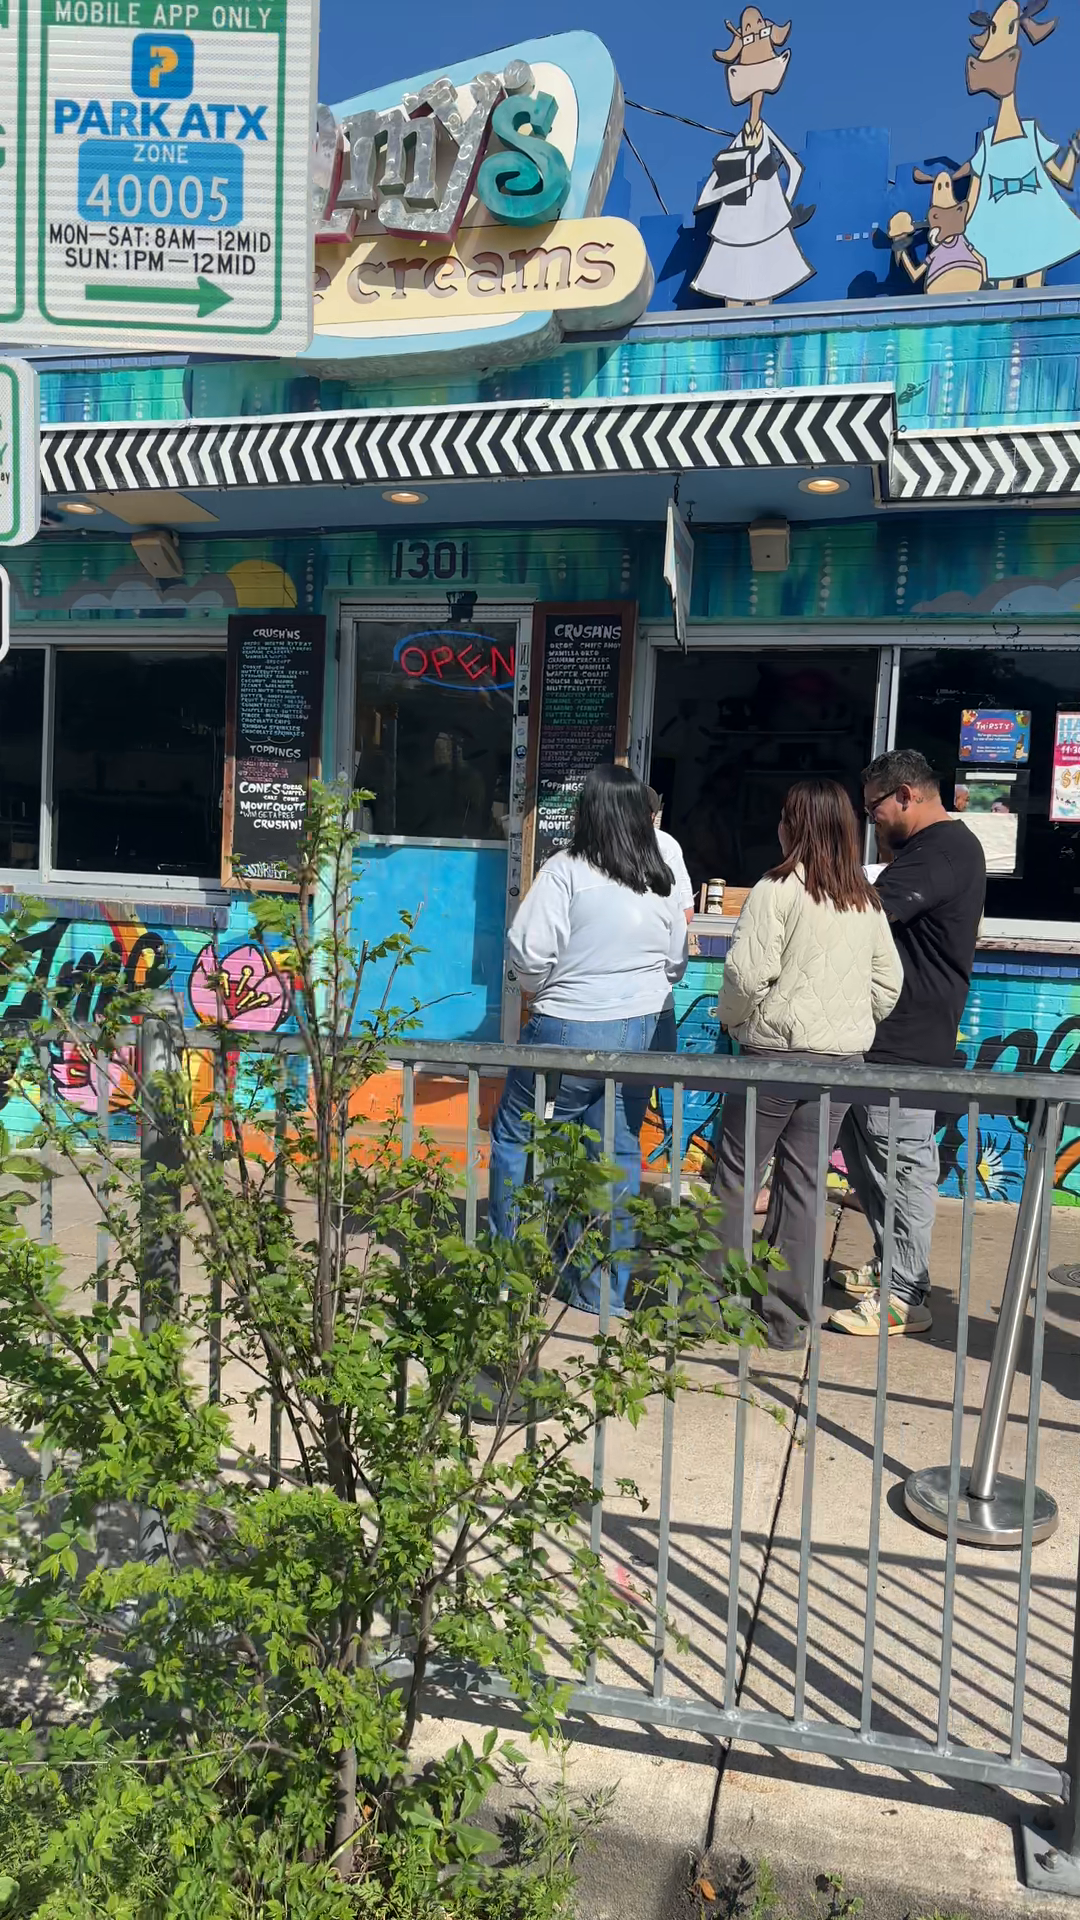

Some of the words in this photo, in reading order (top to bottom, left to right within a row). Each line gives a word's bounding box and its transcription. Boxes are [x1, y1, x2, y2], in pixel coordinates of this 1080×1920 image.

[55, 2, 140, 26] MOBILE
[153, 5, 199, 27] APP
[212, 6, 272, 30] ONLY
[133, 144, 188, 164] ZONE
[86, 173, 229, 222] 40005
[347, 242, 616, 304] creams
[396, 541, 469, 579] 1301
[401, 644, 515, 681] OPEN
[250, 744, 302, 758] TOPPINGS
[239, 781, 282, 795] CONES
[541, 779, 585, 792] TOPPINGS
[240, 801, 273, 812] MOVIE
[273, 802, 306, 812] QUOTE
[538, 807, 567, 815] CONES
[539, 820, 571, 832] MOVIE
